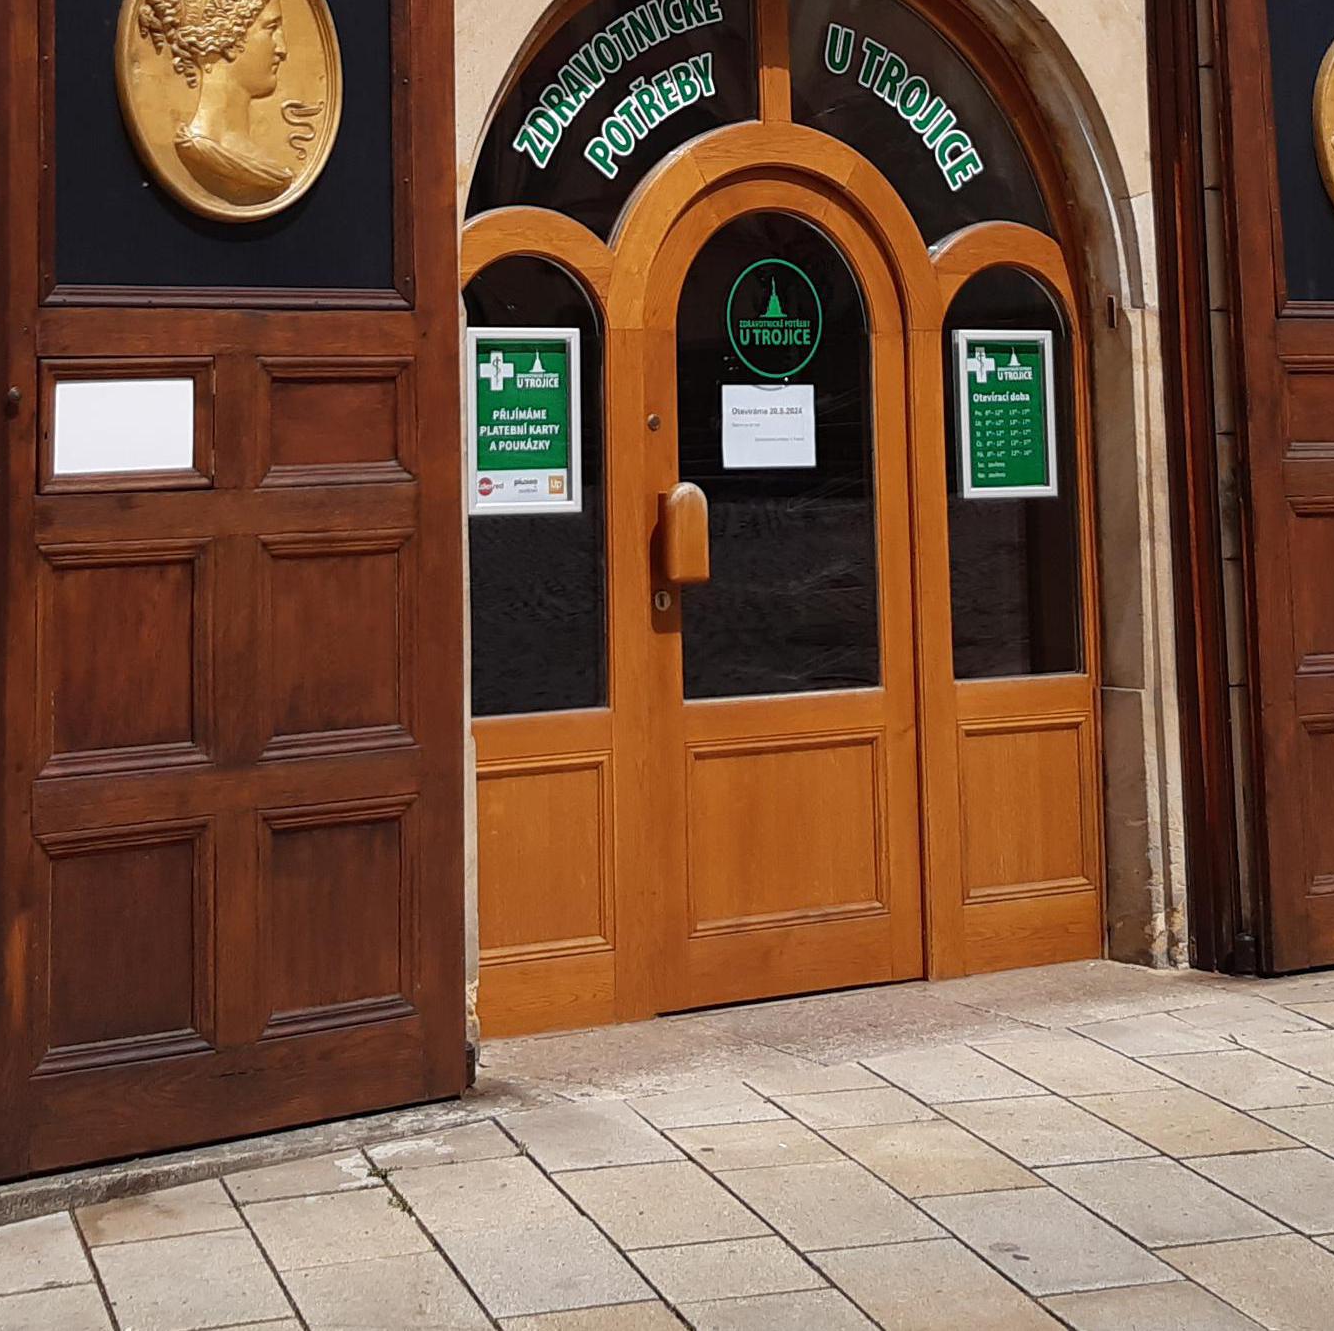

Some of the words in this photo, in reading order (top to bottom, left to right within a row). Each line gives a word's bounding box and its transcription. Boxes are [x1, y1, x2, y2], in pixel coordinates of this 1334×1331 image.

[825, 23, 855, 74] U
[858, 37, 984, 192] TROJICE
[584, 53, 715, 179] POTŘEBY
[739, 329, 750, 345] U
[752, 329, 811, 345] TROJICE
[517, 377, 524, 388] U
[525, 377, 559, 388] TROJICE
[973, 391, 1009, 402] Otevírací
[1011, 392, 1030, 402] doba
[493, 406, 547, 420] PŘIJÍMÁME
[479, 422, 527, 436] PLATEBNÍ
[529, 424, 560, 435] KARTY
[489, 442, 497, 451] A
[499, 437, 551, 451] POUKÁZKY
